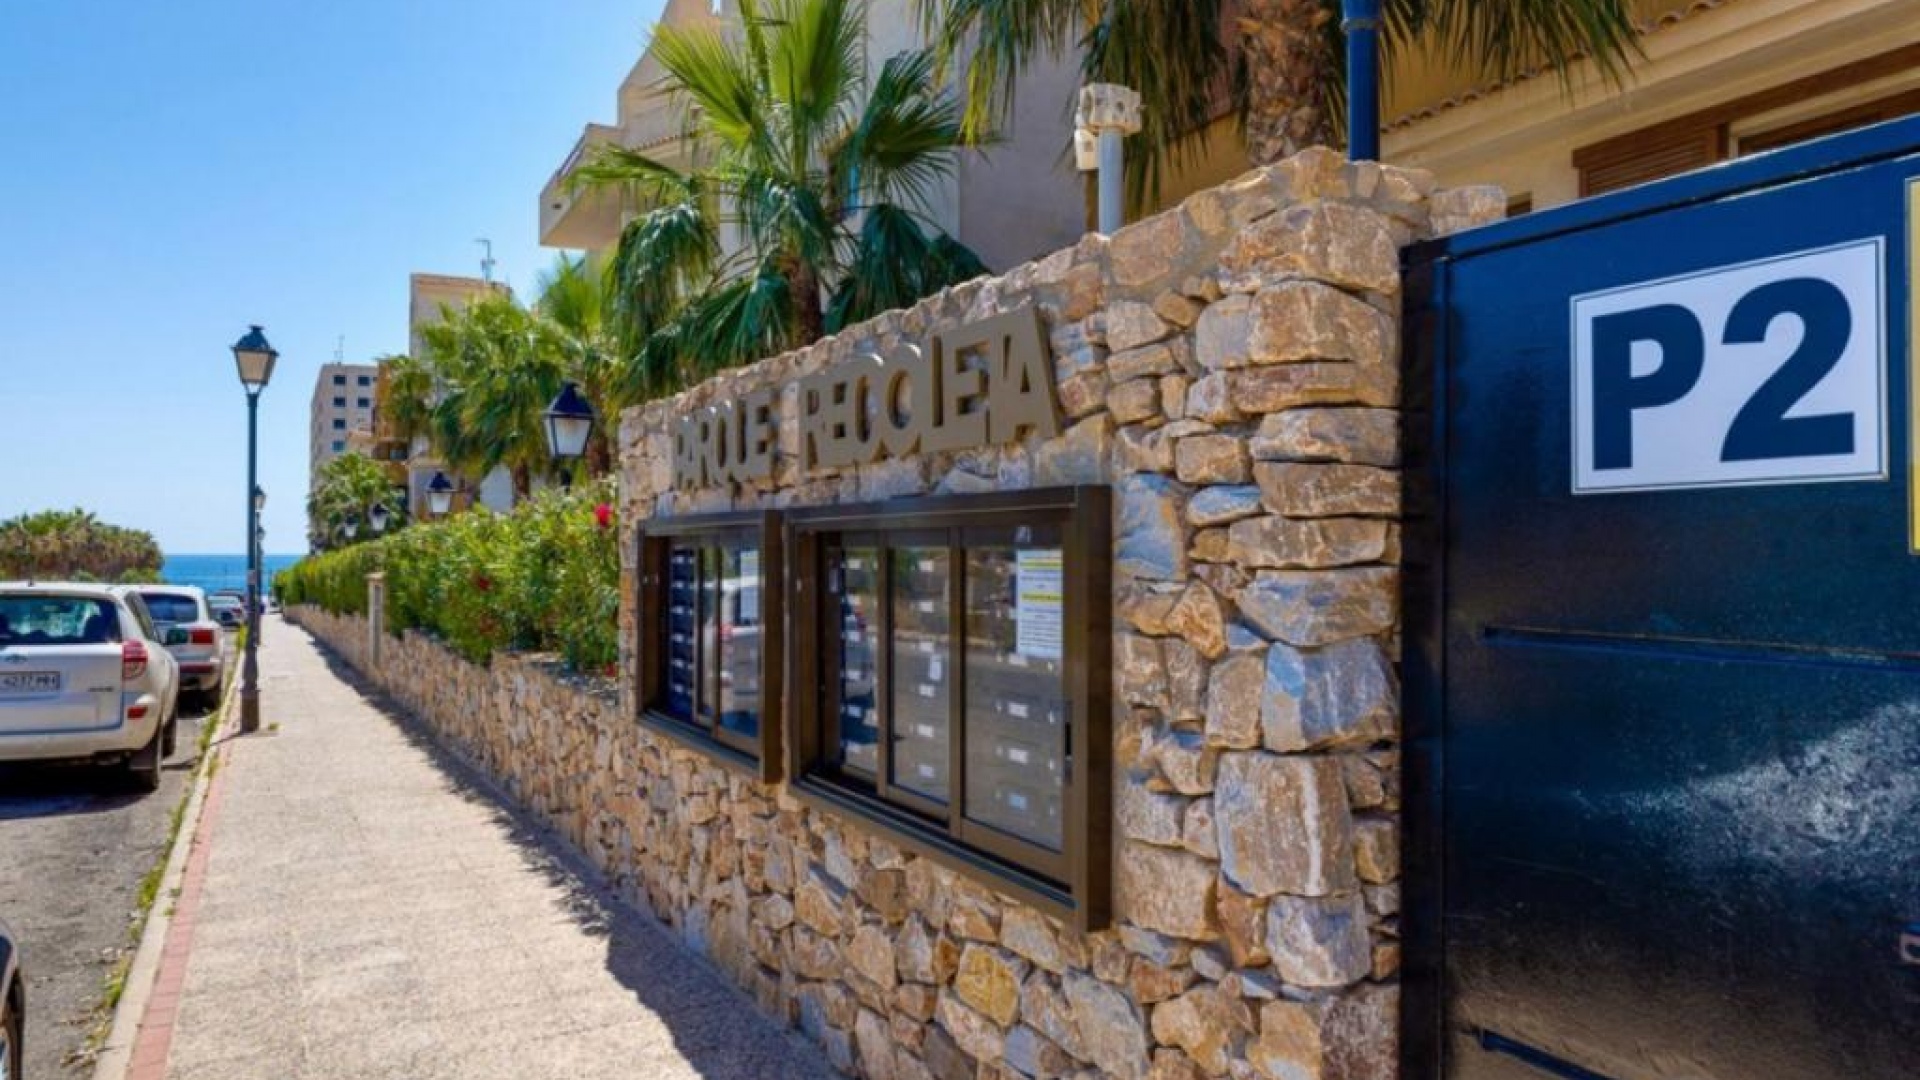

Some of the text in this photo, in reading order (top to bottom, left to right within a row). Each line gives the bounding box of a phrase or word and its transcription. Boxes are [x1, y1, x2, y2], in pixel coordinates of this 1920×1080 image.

[673, 303, 1057, 492] PARQUE RECOLETA
[1592, 277, 1854, 471] P2
